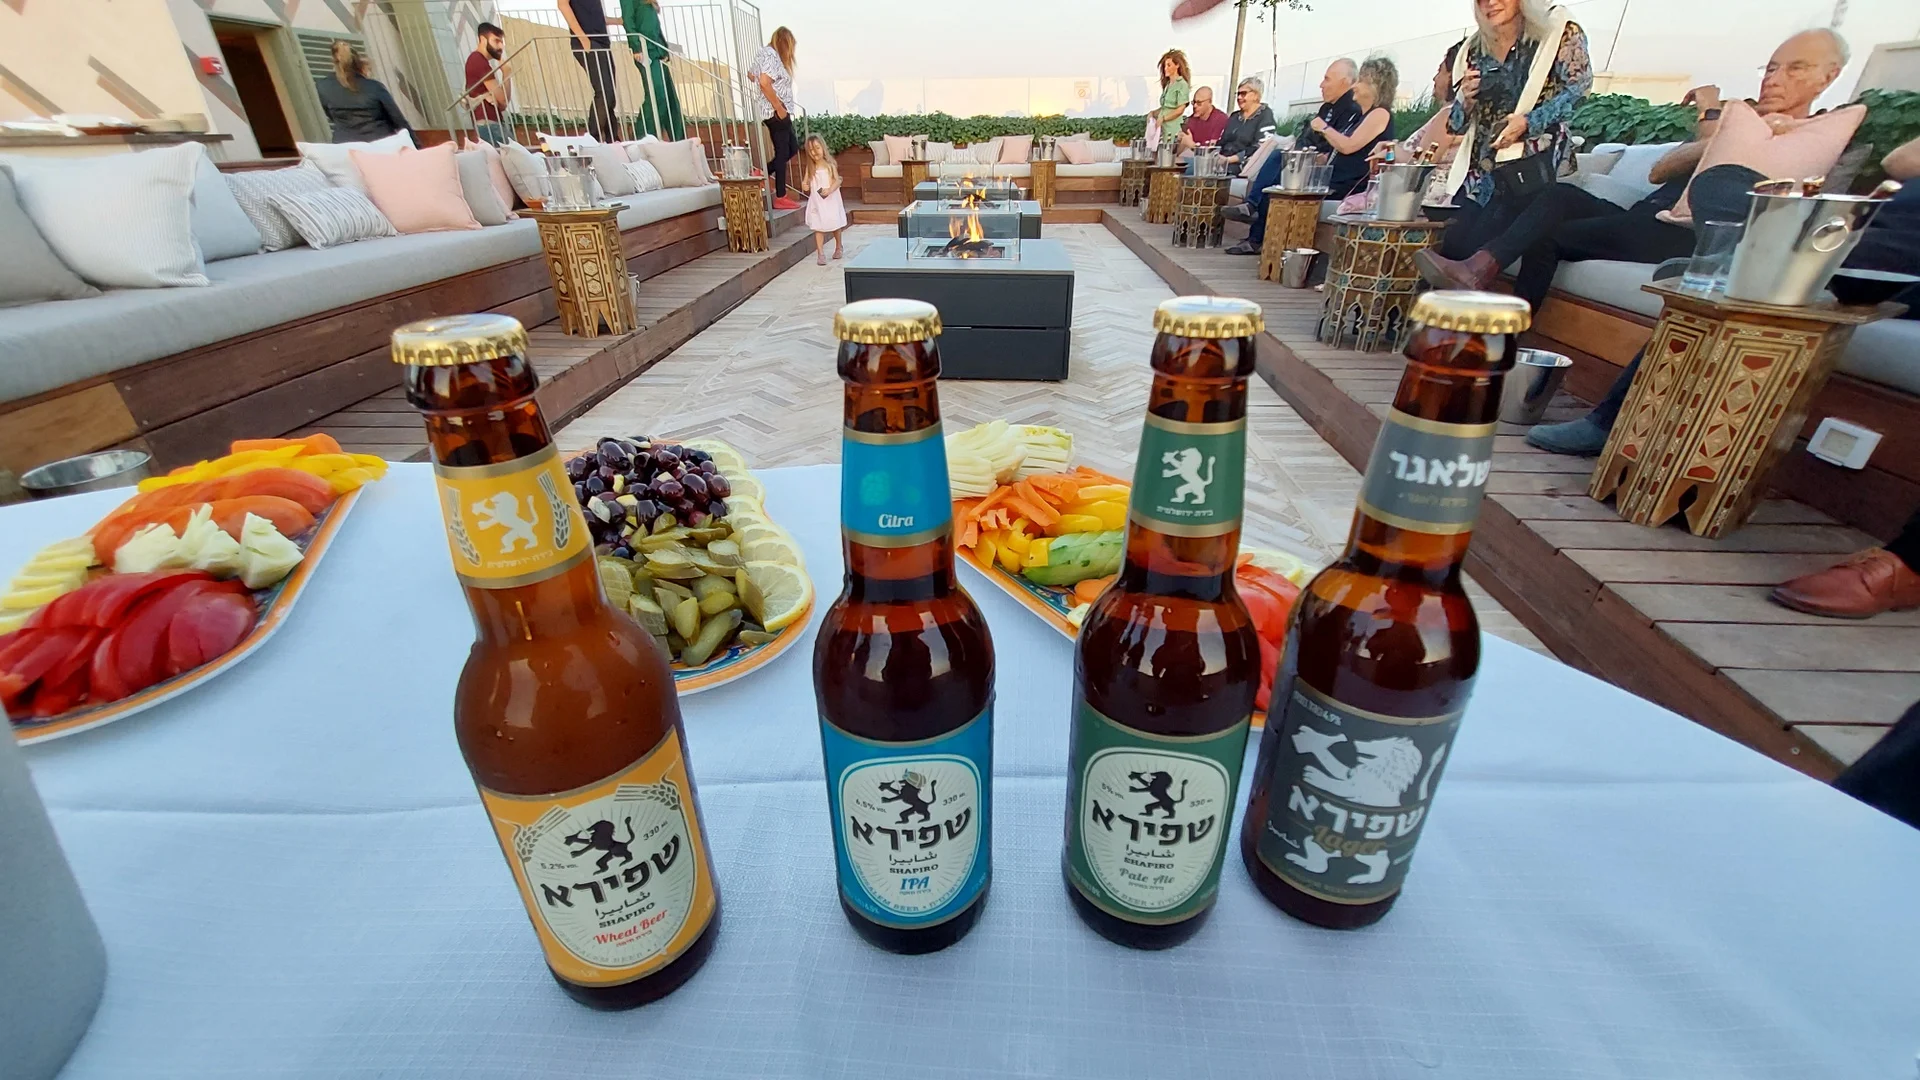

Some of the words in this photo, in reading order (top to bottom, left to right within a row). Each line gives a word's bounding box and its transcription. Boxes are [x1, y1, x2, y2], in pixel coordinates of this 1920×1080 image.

[1389, 450, 1491, 487] שלאגר
[878, 513, 914, 528] Citra
[1092, 799, 1216, 846] שפירא
[1288, 785, 1425, 839] שפירא
[643, 826, 660, 841] 330
[851, 807, 972, 850] שפירא
[540, 833, 681, 908] שפירא
[889, 864, 939, 875] SHAPIRO
[1123, 857, 1175, 869] SHAPIRO
[900, 876, 930, 890] IPA
[1119, 868, 1149, 883] Pale
[1153, 874, 1175, 885] Ale
[593, 925, 638, 945] Wheat
[639, 909, 668, 931] Beer
[598, 902, 656, 928] SHAPIRO
